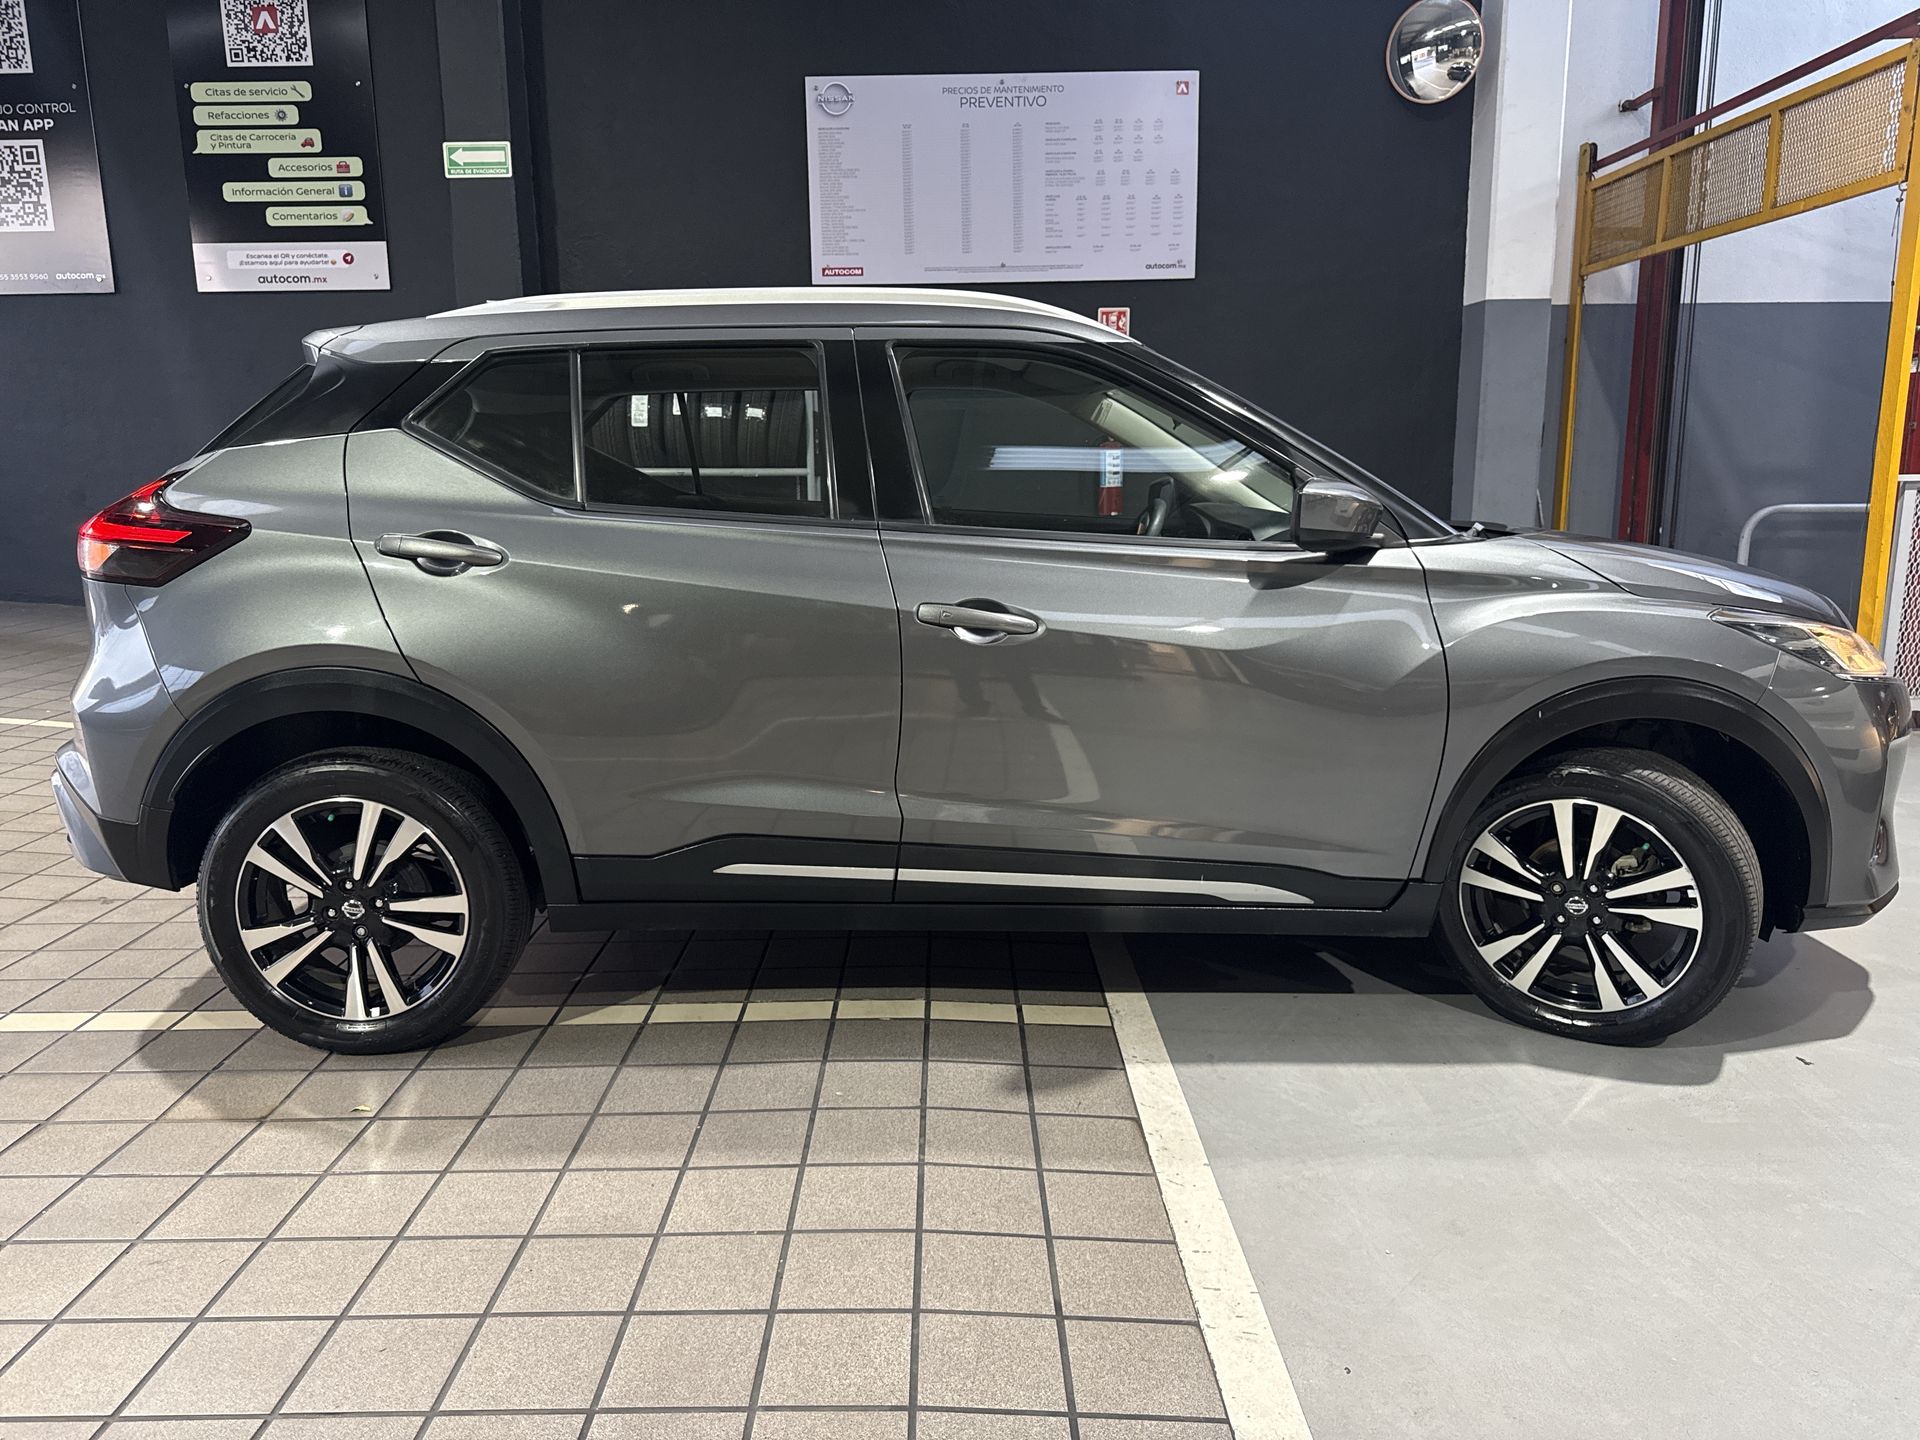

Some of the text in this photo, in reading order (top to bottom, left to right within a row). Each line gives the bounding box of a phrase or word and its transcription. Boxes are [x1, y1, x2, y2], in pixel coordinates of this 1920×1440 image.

[204, 87, 288, 97] Citas de servicio
[942, 84, 1065, 95] PRECIOS DE MANTENIMIENTO
[960, 95, 1047, 108] PREVENTIVO
[16, 102, 77, 115] CONTROL
[207, 111, 270, 120] Refacciones
[0, 118, 55, 132] AN APP
[209, 133, 234, 142] Citas
[235, 133, 248, 141] de
[210, 141, 252, 151] y Pintura
[278, 163, 333, 172] Accesorios
[231, 186, 335, 197] Información General
[272, 211, 338, 221] Comentarios
[257, 273, 328, 284] autocom.mx
